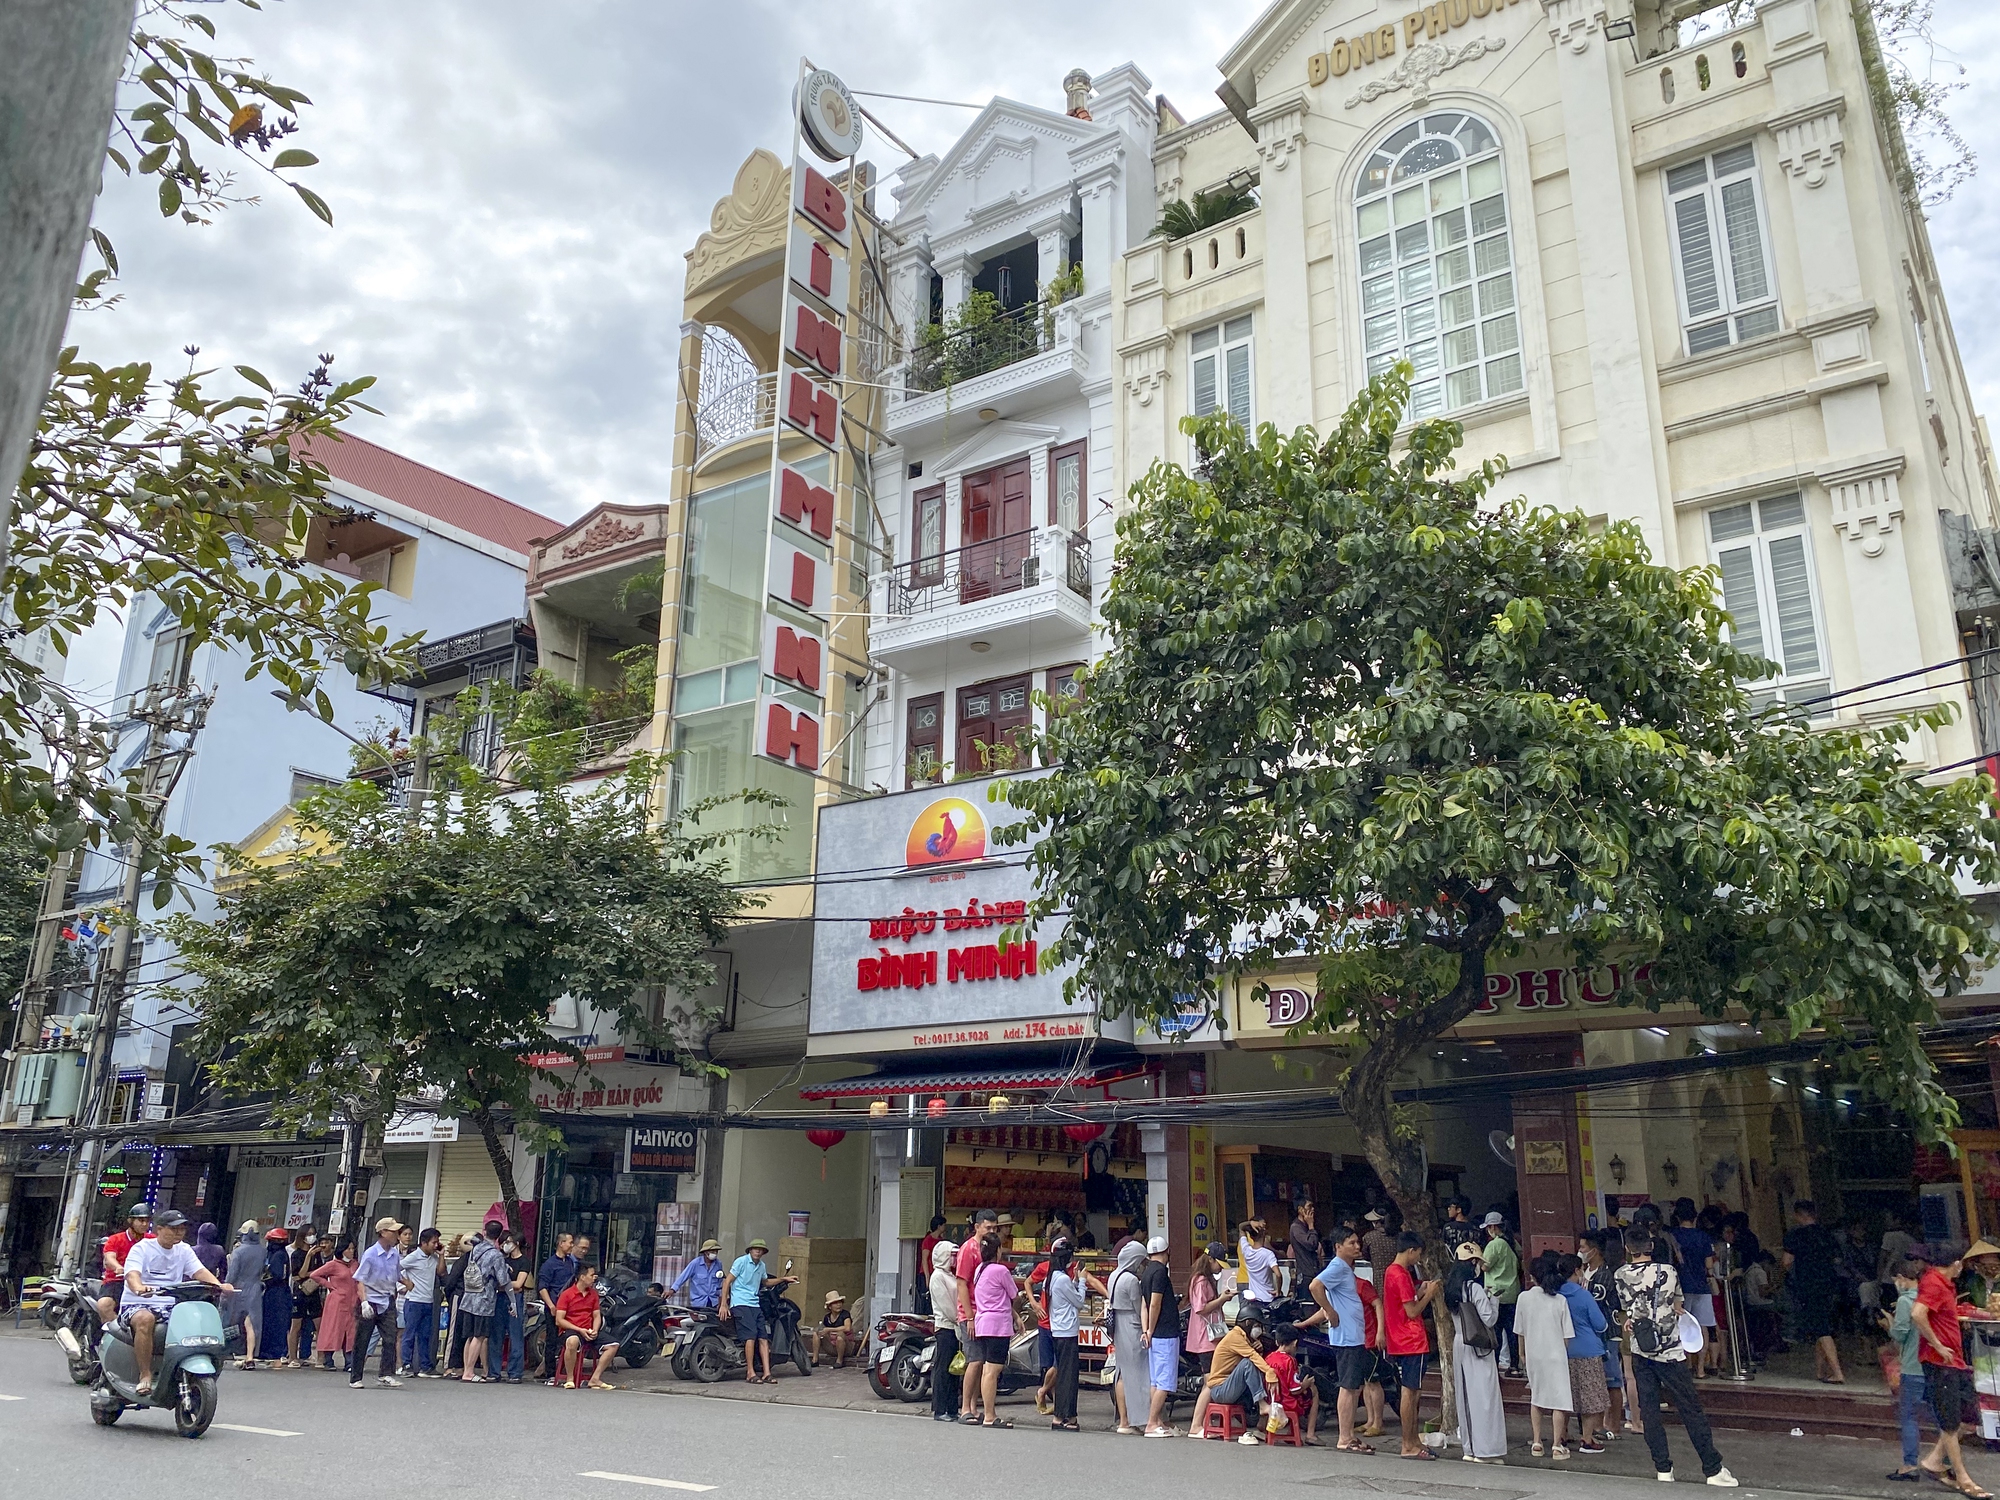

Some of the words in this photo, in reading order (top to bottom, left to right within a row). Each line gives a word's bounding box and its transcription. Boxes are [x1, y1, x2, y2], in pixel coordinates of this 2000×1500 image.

[1308, 24, 1396, 88] ĐÔNG
[811, 76, 823, 106] TRUNG
[822, 73, 840, 91] TÂM
[766, 468, 834, 771] MINH
[929, 874, 949, 884] SINCE
[868, 906, 938, 943] HIỆU
[943, 897, 1027, 932] BÁNH
[857, 947, 938, 991] BÌNH
[947, 940, 1038, 984] MINH
[535, 1092, 549, 1109] GA
[633, 1077, 663, 1108] QUỐC
[291, 1193, 312, 1206] 20%
[287, 1214, 309, 1227] 50%
[1196, 1215, 1206, 1227] 172
